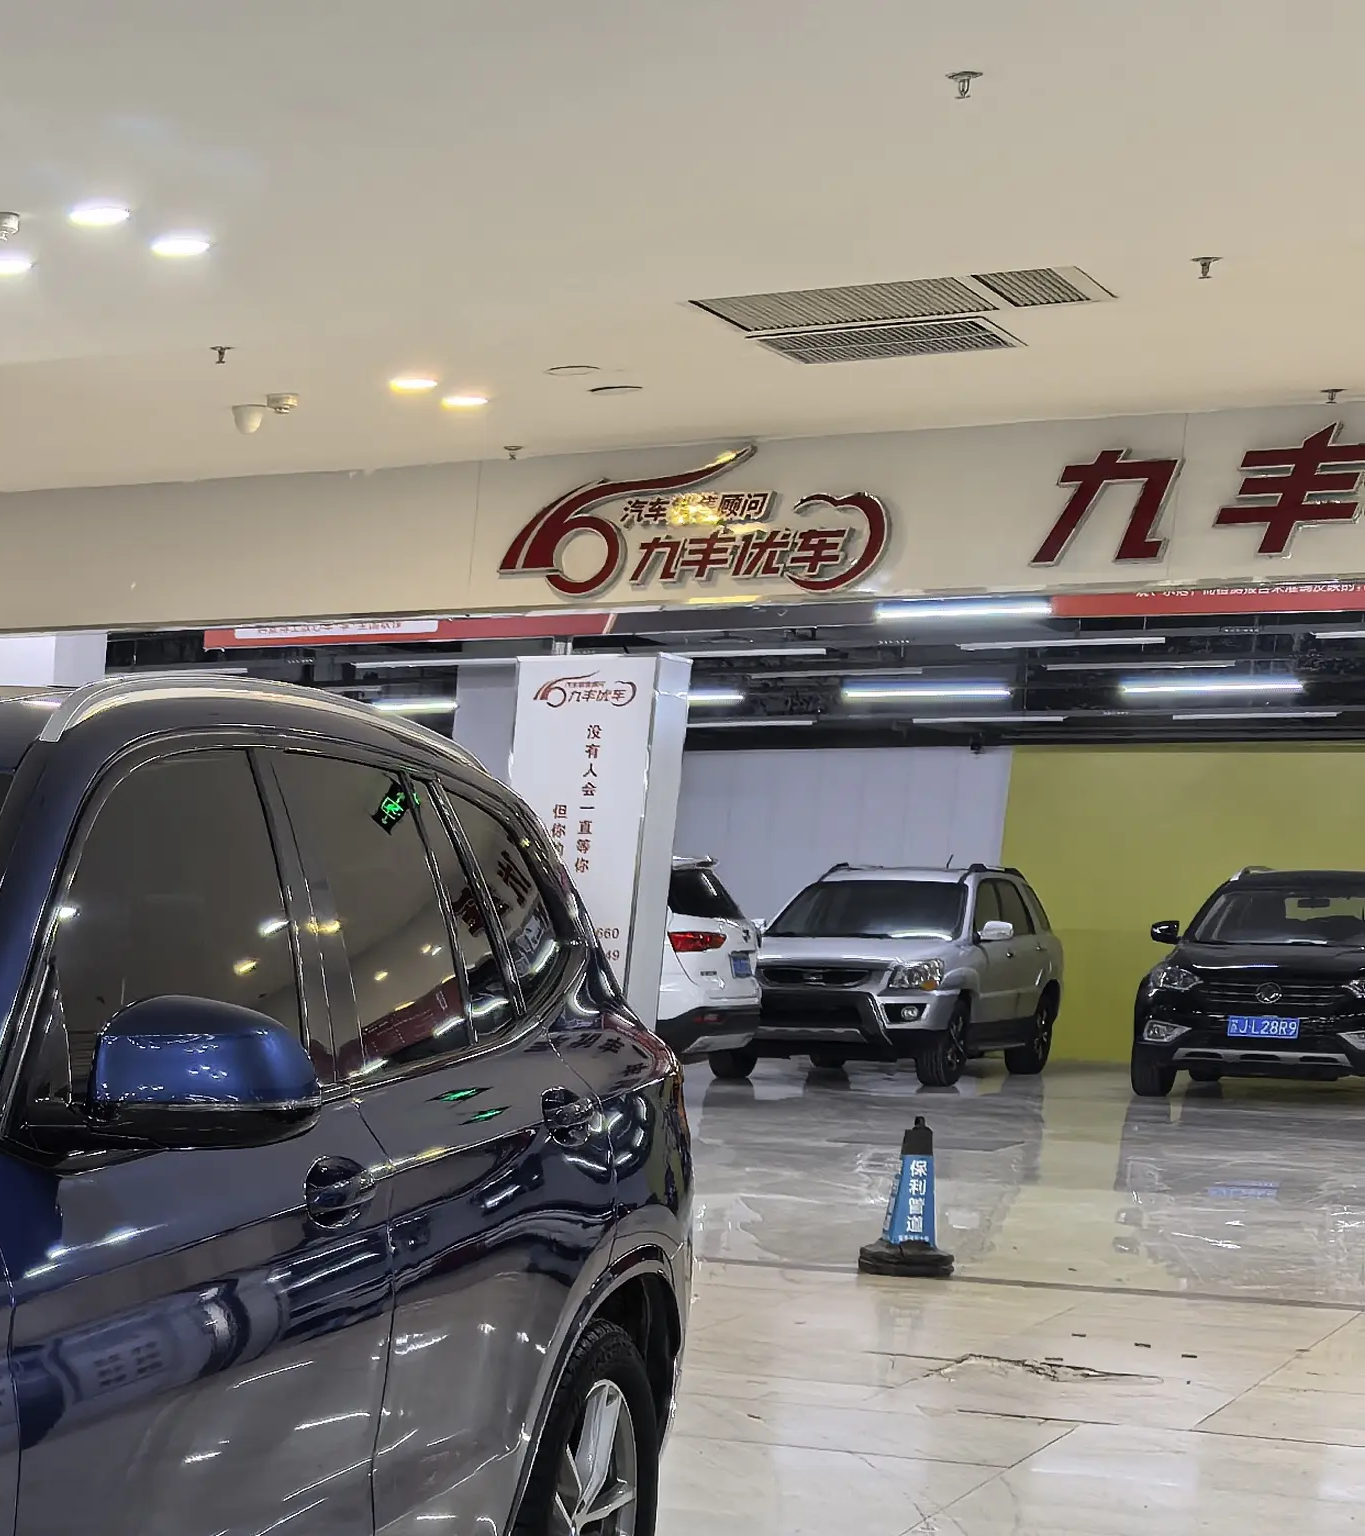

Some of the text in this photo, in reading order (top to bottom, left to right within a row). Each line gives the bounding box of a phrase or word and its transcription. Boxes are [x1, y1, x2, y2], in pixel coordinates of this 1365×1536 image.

[620, 492, 770, 523] 汽车顾问
[1029, 421, 1365, 566] 九丰
[630, 528, 847, 580] 九丰优车
[574, 724, 603, 874] 没有人会一直等你
